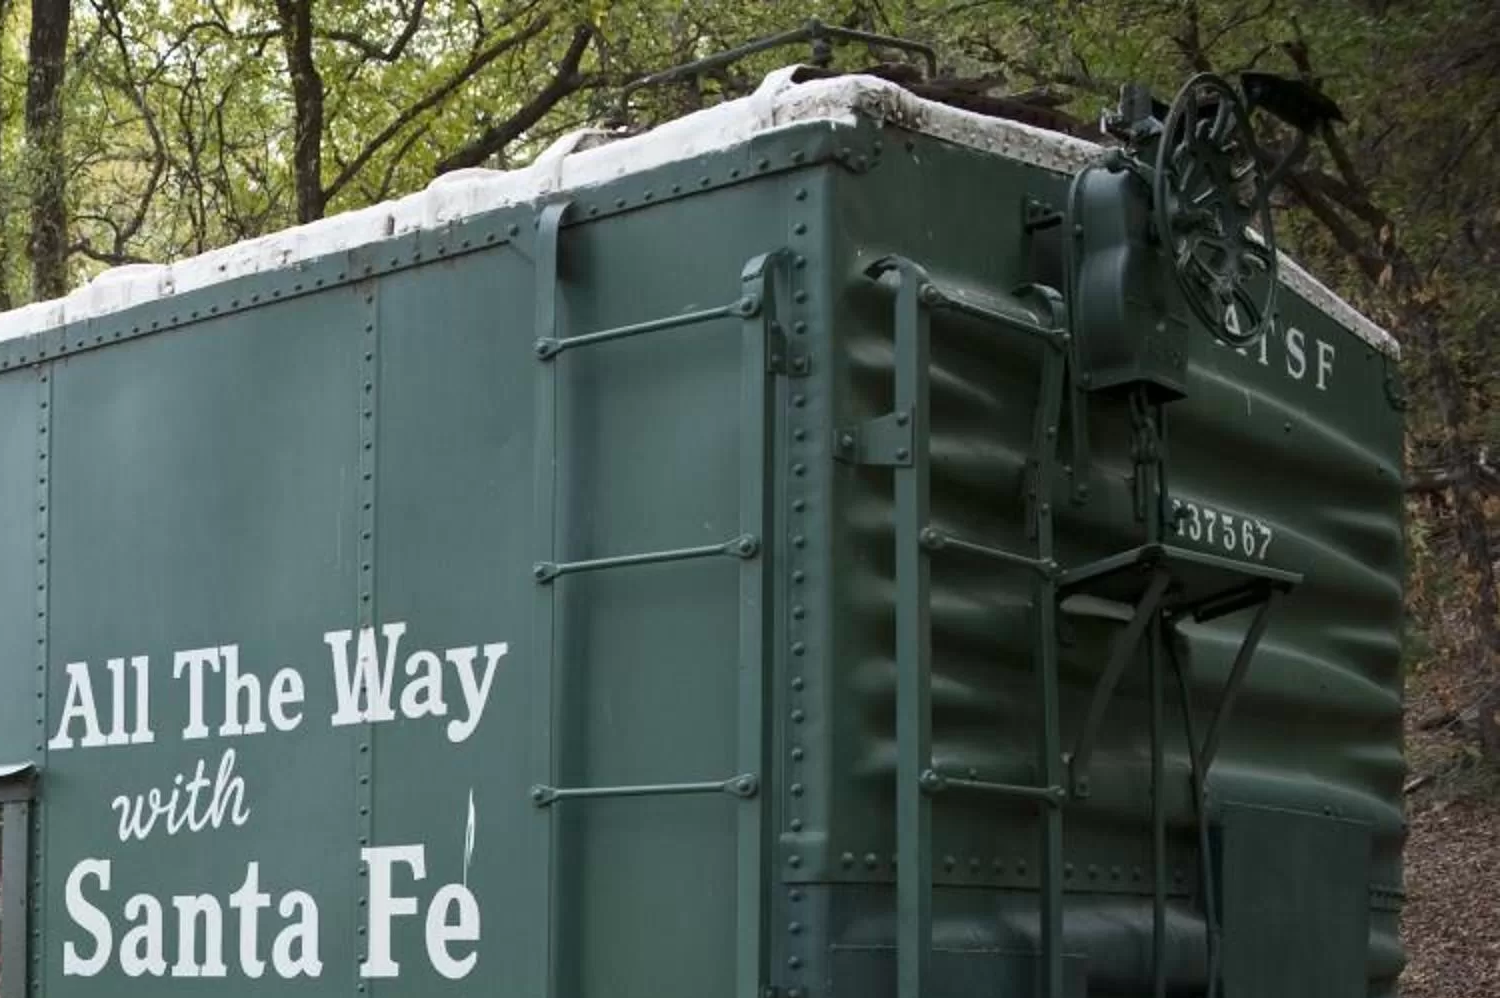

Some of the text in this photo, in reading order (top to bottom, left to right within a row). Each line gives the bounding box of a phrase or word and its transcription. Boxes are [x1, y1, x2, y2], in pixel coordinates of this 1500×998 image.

[48, 621, 508, 750] All The Way
[111, 748, 250, 842] with
[63, 857, 324, 979] Santa
